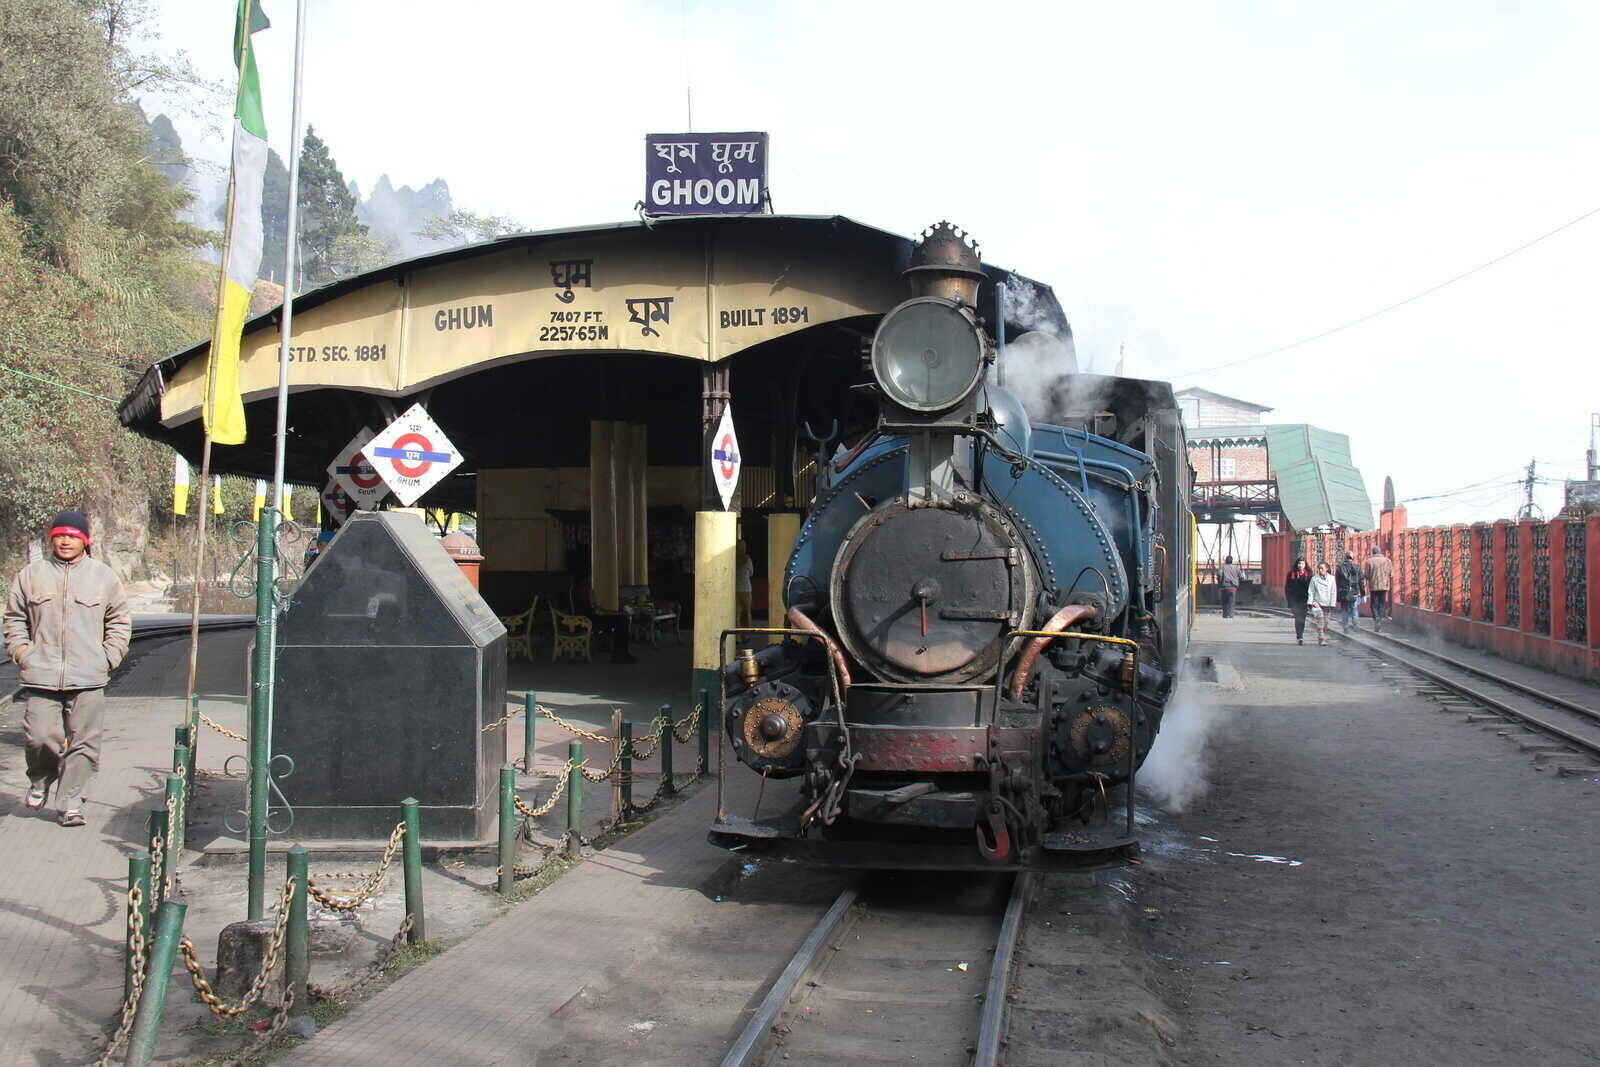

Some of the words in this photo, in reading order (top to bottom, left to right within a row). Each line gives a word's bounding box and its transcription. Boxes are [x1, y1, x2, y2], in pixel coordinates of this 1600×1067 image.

[710, 142, 759, 173] घूम
[652, 179, 759, 205] GHOOM
[549, 259, 594, 304] घुम
[434, 304, 493, 331] GHUM
[550, 311, 581, 323] 7407
[583, 311, 603, 323] FT.
[625, 297, 674, 338] ঘুম
[720, 308, 766, 329] BUILT
[770, 306, 809, 325] 1891
[322, 345, 350, 361] SEC.
[354, 343, 386, 361] 1881
